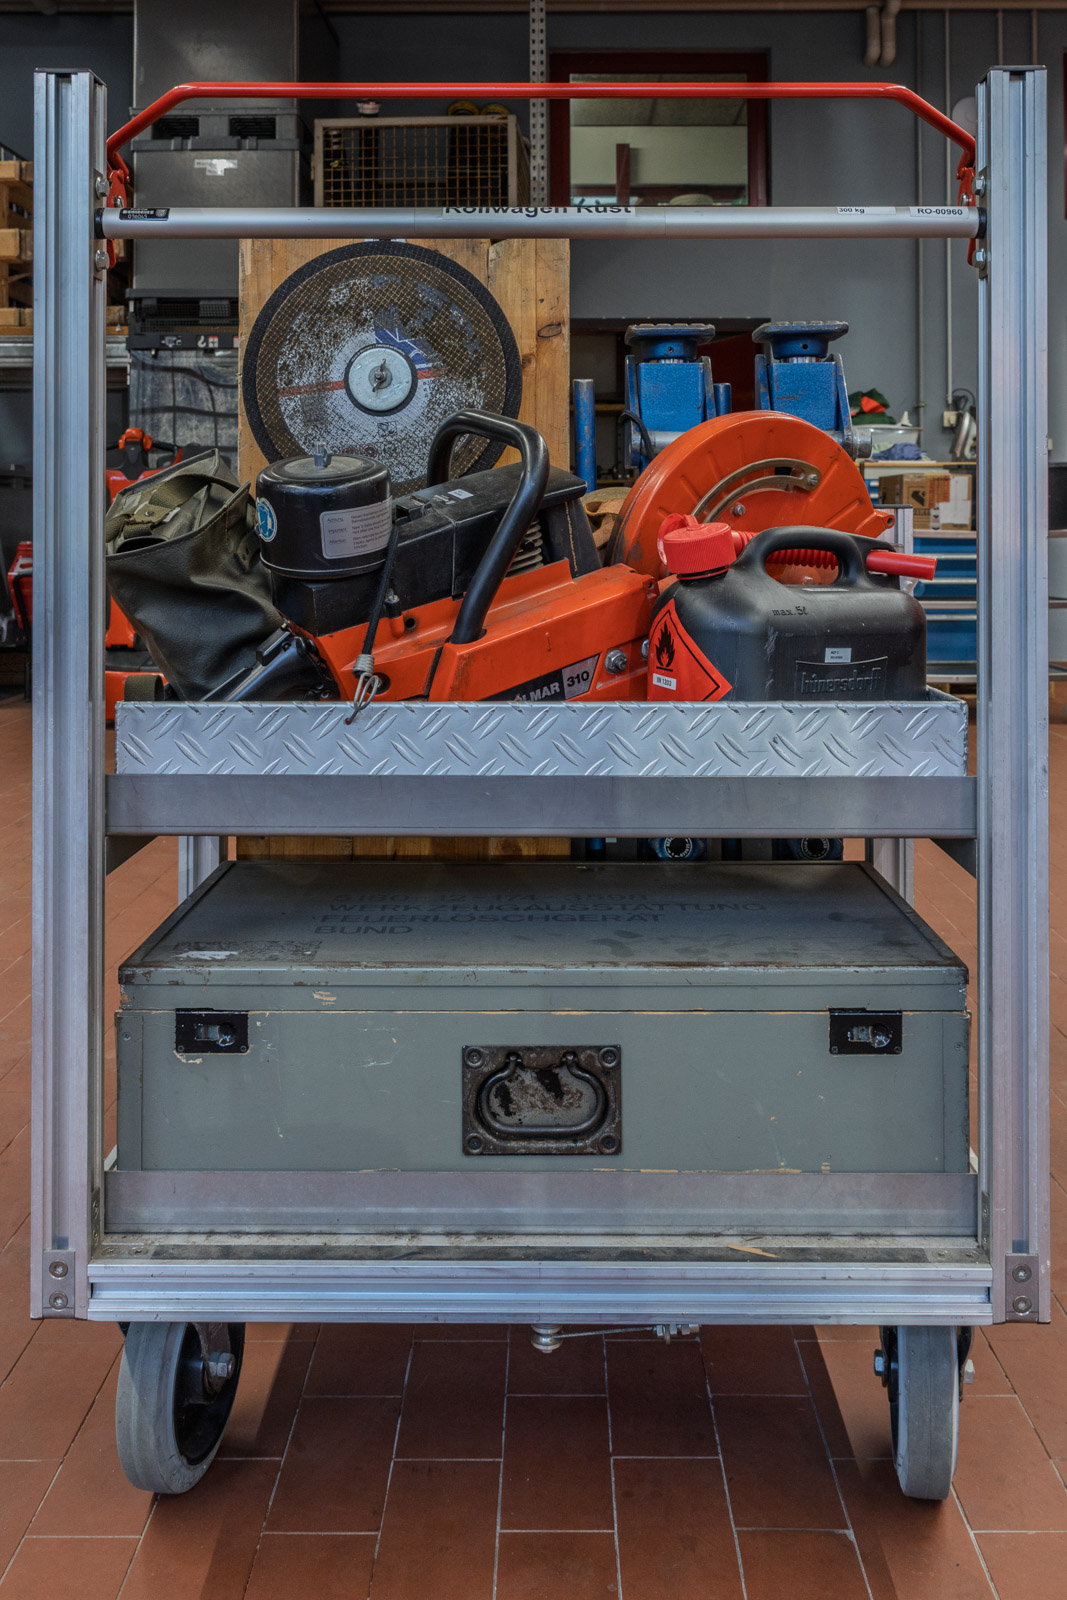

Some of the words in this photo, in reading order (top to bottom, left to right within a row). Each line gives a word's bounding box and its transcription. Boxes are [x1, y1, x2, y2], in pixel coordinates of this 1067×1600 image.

[567, 670, 590, 687] 310
[319, 912, 665, 923] FEUERLÖSCHGERÄT
[314, 925, 413, 935] BUND
